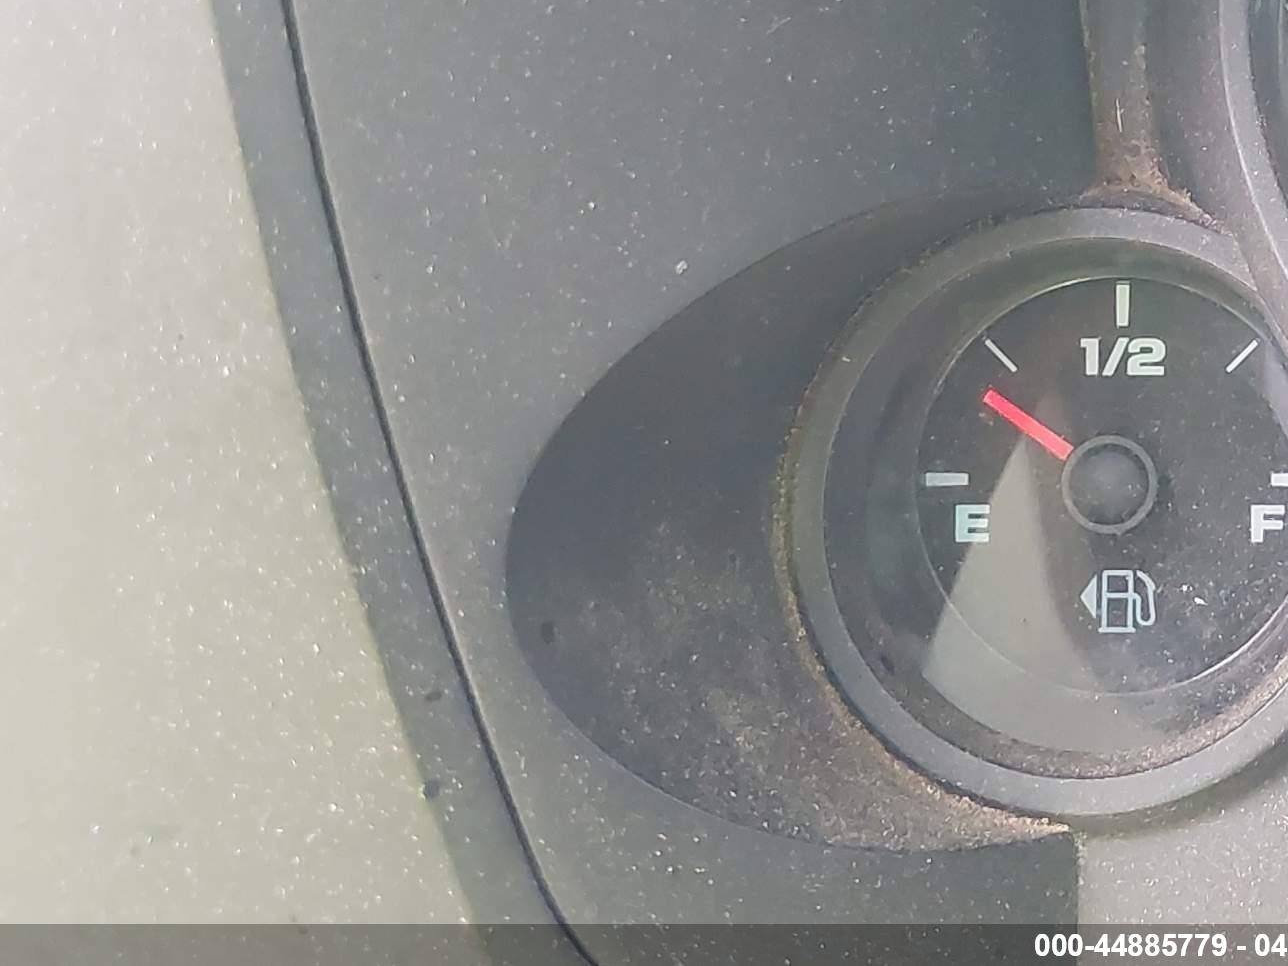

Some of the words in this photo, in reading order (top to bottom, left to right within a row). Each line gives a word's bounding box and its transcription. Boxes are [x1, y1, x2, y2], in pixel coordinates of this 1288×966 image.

[1080, 337, 1166, 376] 1/2
[955, 504, 990, 543] E
[1250, 504, 1285, 543] F
